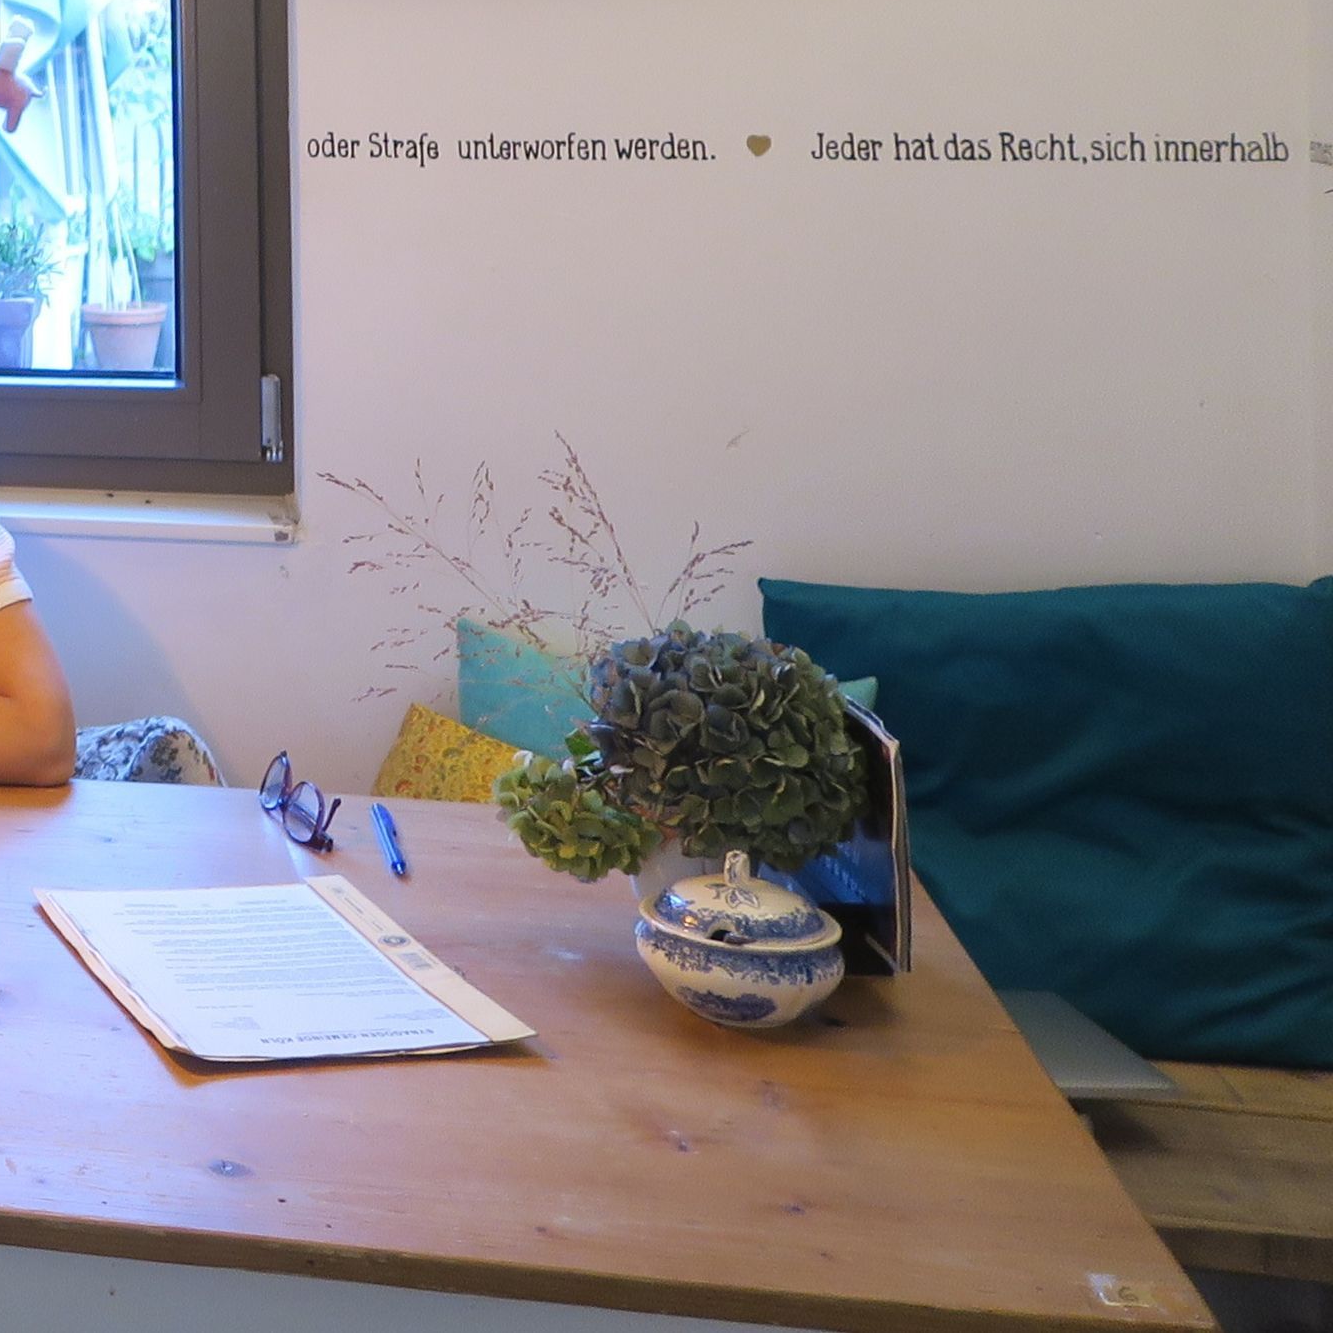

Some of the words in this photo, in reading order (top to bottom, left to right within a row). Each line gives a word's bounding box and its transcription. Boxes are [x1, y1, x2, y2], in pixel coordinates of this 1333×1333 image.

[306, 131, 361, 160] oder
[368, 132, 440, 168] Strafe
[458, 132, 608, 161] unterworfen
[614, 132, 717, 161] werden.
[810, 131, 884, 161] Jeder
[893, 132, 935, 161] hat
[944, 132, 992, 161] das
[999, 132, 1088, 165] Recht,
[1090, 131, 1146, 162] sich
[1154, 132, 1290, 162] innerhalb
